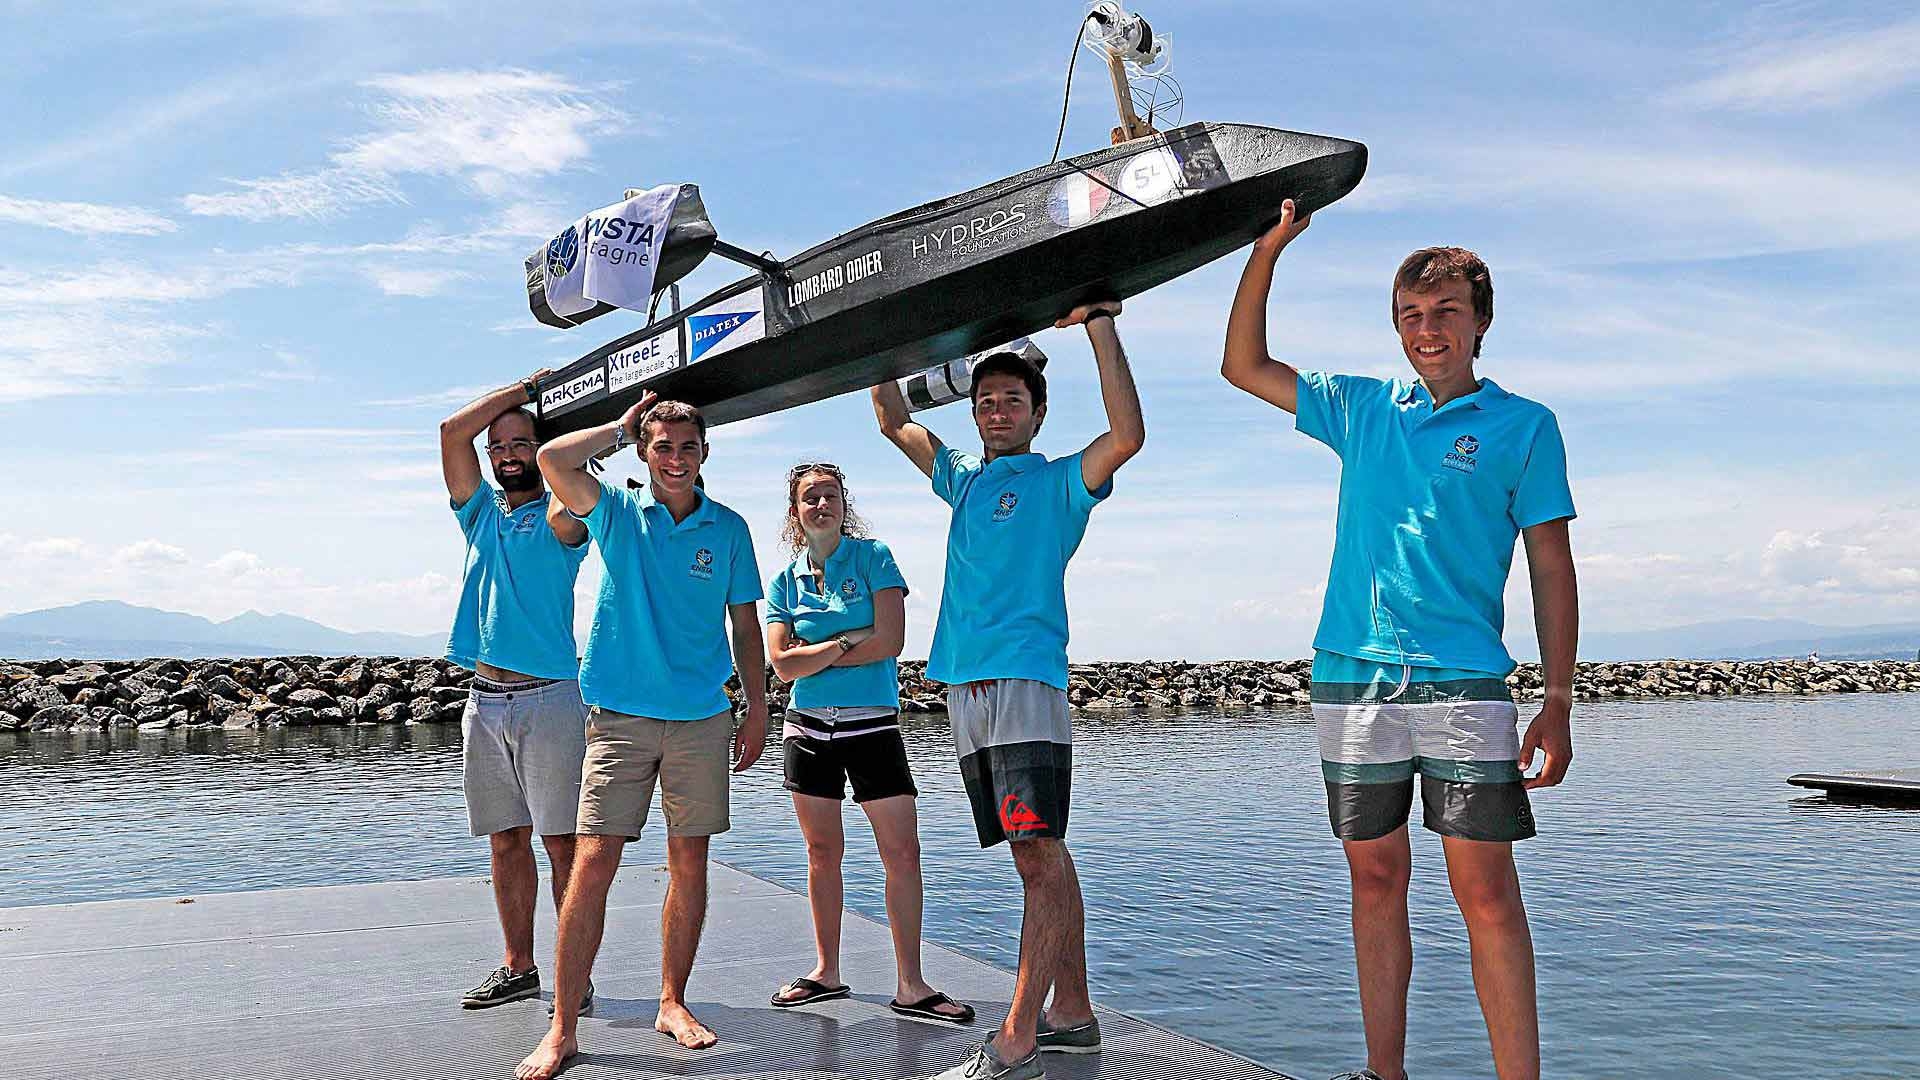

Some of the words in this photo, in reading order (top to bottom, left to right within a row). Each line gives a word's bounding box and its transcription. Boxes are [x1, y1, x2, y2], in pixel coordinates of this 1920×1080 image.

[585, 216, 655, 248] NSTA
[911, 203, 1027, 259] HYDROS
[951, 225, 1028, 259] FOUNDATION
[589, 241, 649, 266] tagne
[787, 265, 844, 308] LOMBARD
[845, 250, 883, 284] ODIER
[695, 316, 741, 343] DIATEX
[609, 336, 661, 374] XtreeE
[542, 373, 604, 408] ARKEMA
[610, 376, 623, 388] The
[625, 360, 665, 381] large-scale
[1444, 452, 1477, 467] ENSTA
